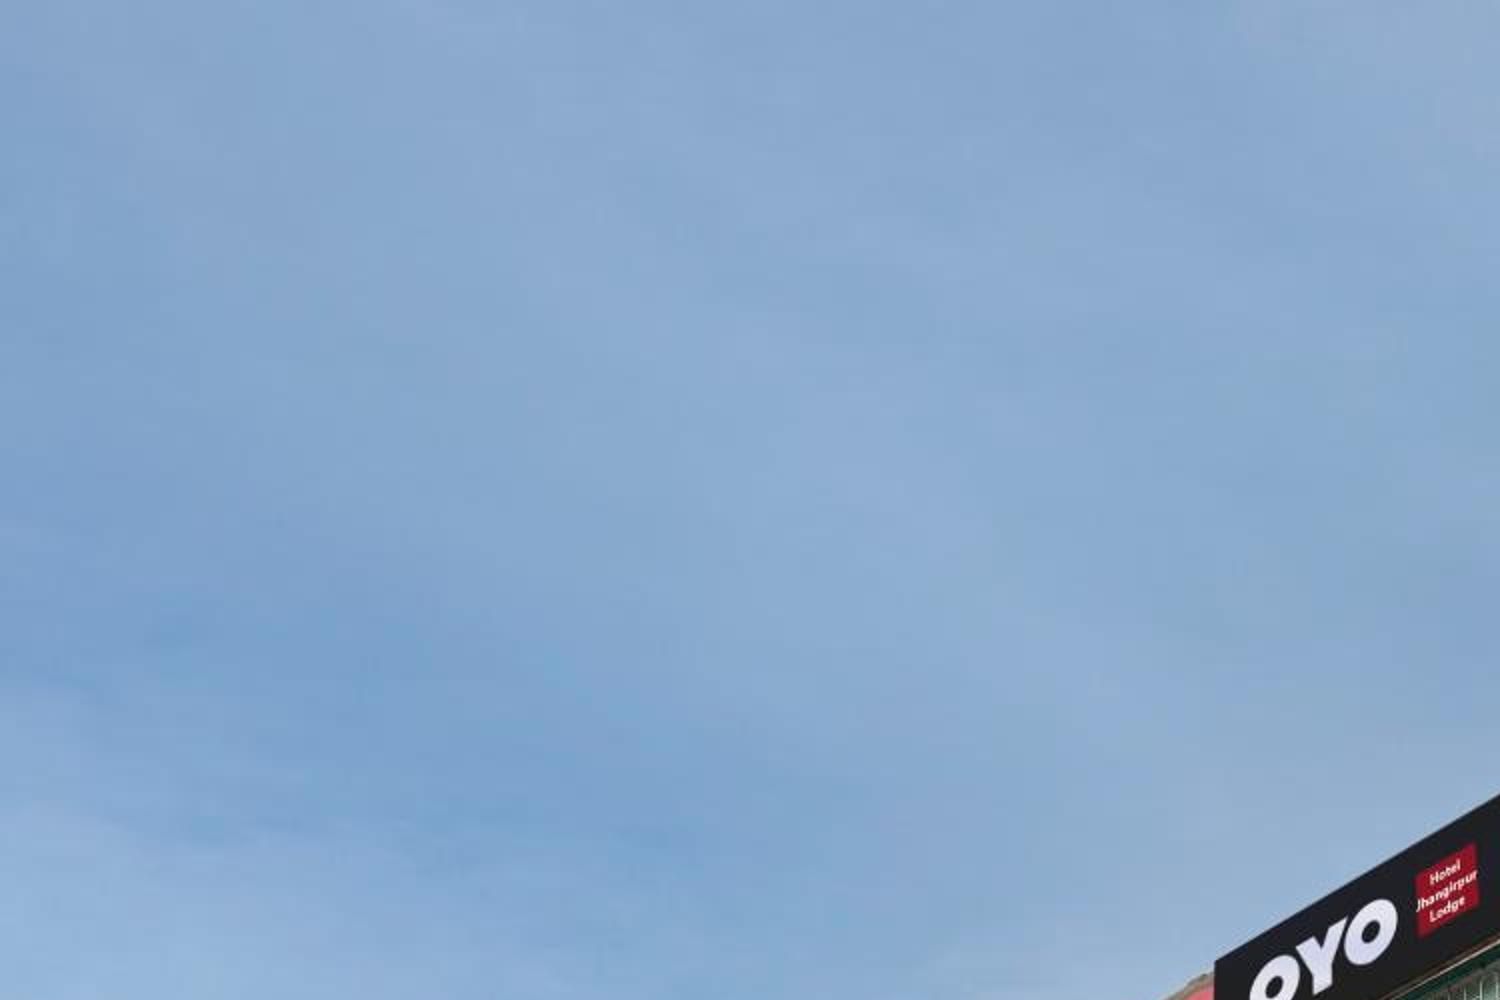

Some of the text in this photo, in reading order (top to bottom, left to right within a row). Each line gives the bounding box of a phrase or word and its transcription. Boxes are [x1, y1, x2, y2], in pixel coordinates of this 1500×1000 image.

[1429, 858, 1461, 886] Hotel
[1415, 870, 1478, 913] Jhangirpur
[1429, 896, 1465, 923] Lodge
